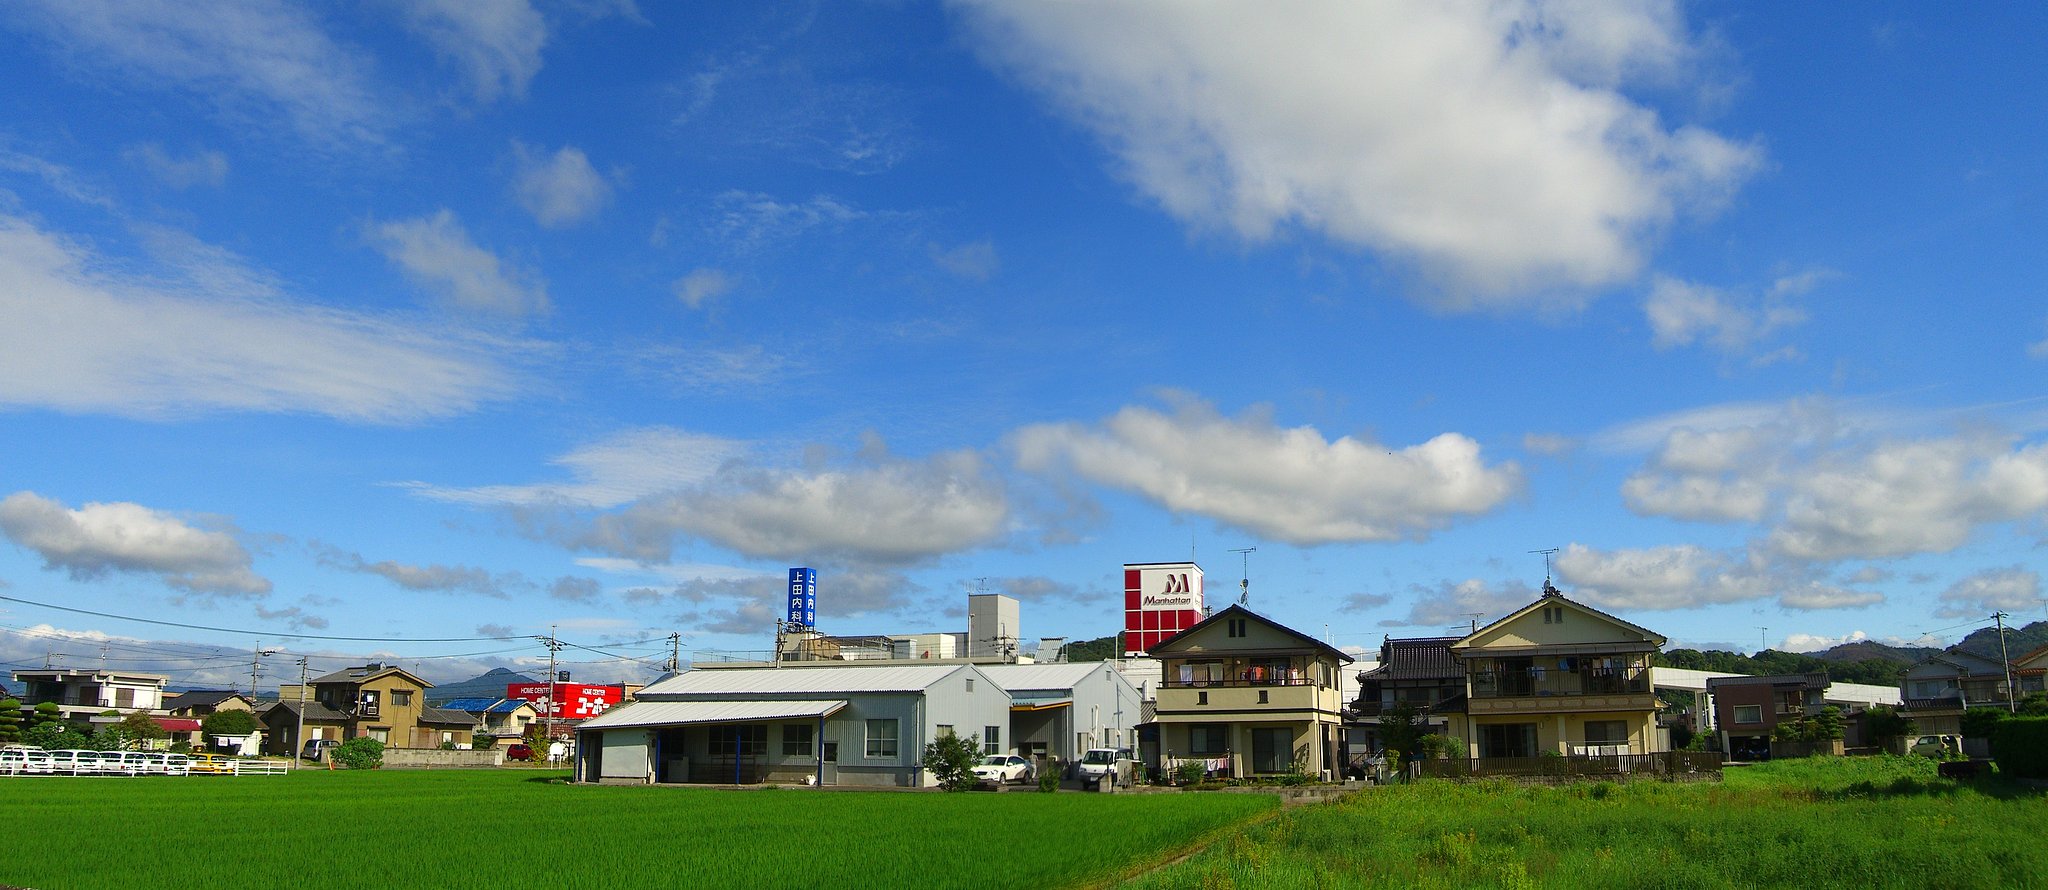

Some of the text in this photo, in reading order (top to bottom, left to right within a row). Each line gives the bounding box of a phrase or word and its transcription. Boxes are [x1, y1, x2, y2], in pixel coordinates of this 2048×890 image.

[792, 571, 803, 621] 上田内科
[807, 572, 815, 622] 上田内科
[1143, 595, 1191, 606] Manhattan
